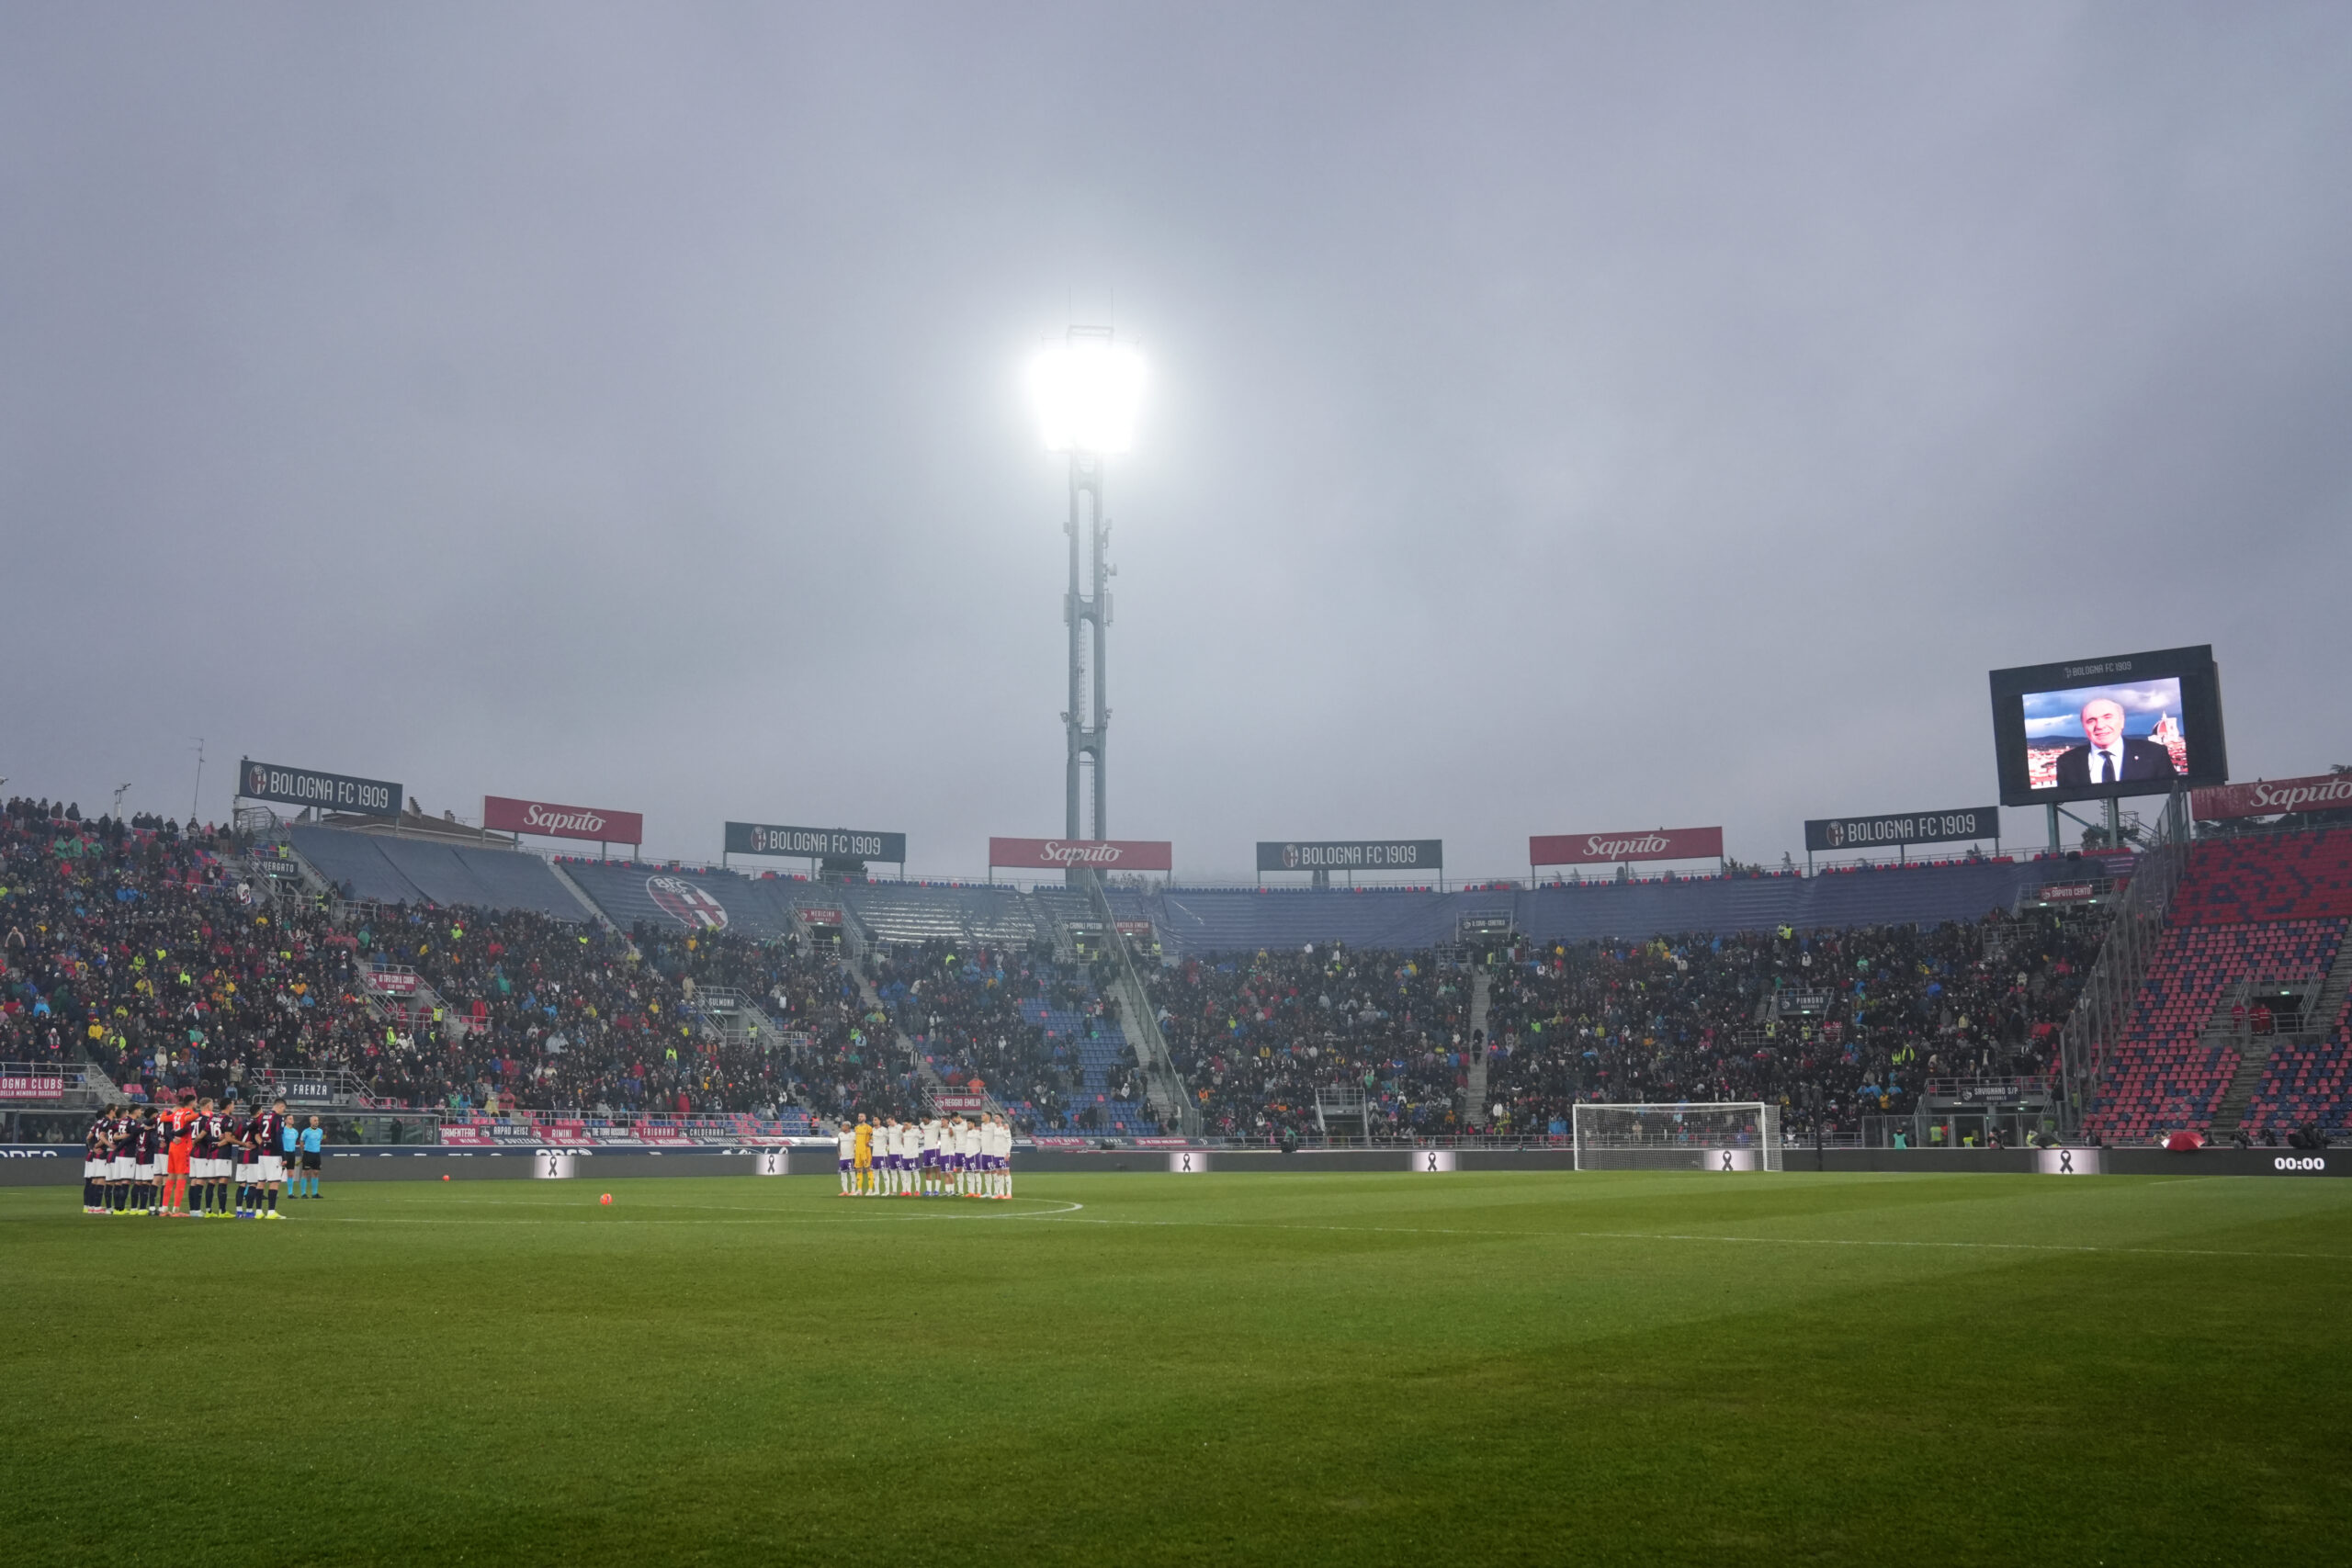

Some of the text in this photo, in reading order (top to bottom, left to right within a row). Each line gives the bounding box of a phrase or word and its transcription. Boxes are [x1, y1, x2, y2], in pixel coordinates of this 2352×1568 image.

[2072, 660, 2132, 677] BOLOGNA FC 1909
[270, 771, 389, 809] BOLOGNA FC 1909
[2250, 777, 2352, 811] Saputo
[523, 804, 606, 835] Saputo
[1848, 814, 1975, 843] BOLOGNA FC 1909
[769, 830, 881, 855] BOLOGNA FC 1909
[1582, 833, 1671, 861] Saputo
[1040, 840, 1124, 867] Saputo
[1302, 845, 1417, 865] BOLOGNA FC 1909
[0, 1078, 63, 1089] OGNA CLUBS
[293, 1084, 328, 1096] FAENZA
[1973, 1087, 2006, 1096] SAVIGNANO
[209, 1121, 222, 1138] 16
[262, 1120, 270, 1138] 2
[551, 1129, 572, 1138] RIMINI
[643, 1127, 675, 1136] FRIGNANO
[689, 1128, 725, 1136] CALDERARA
[2274, 1156, 2325, 1170] 00:00
